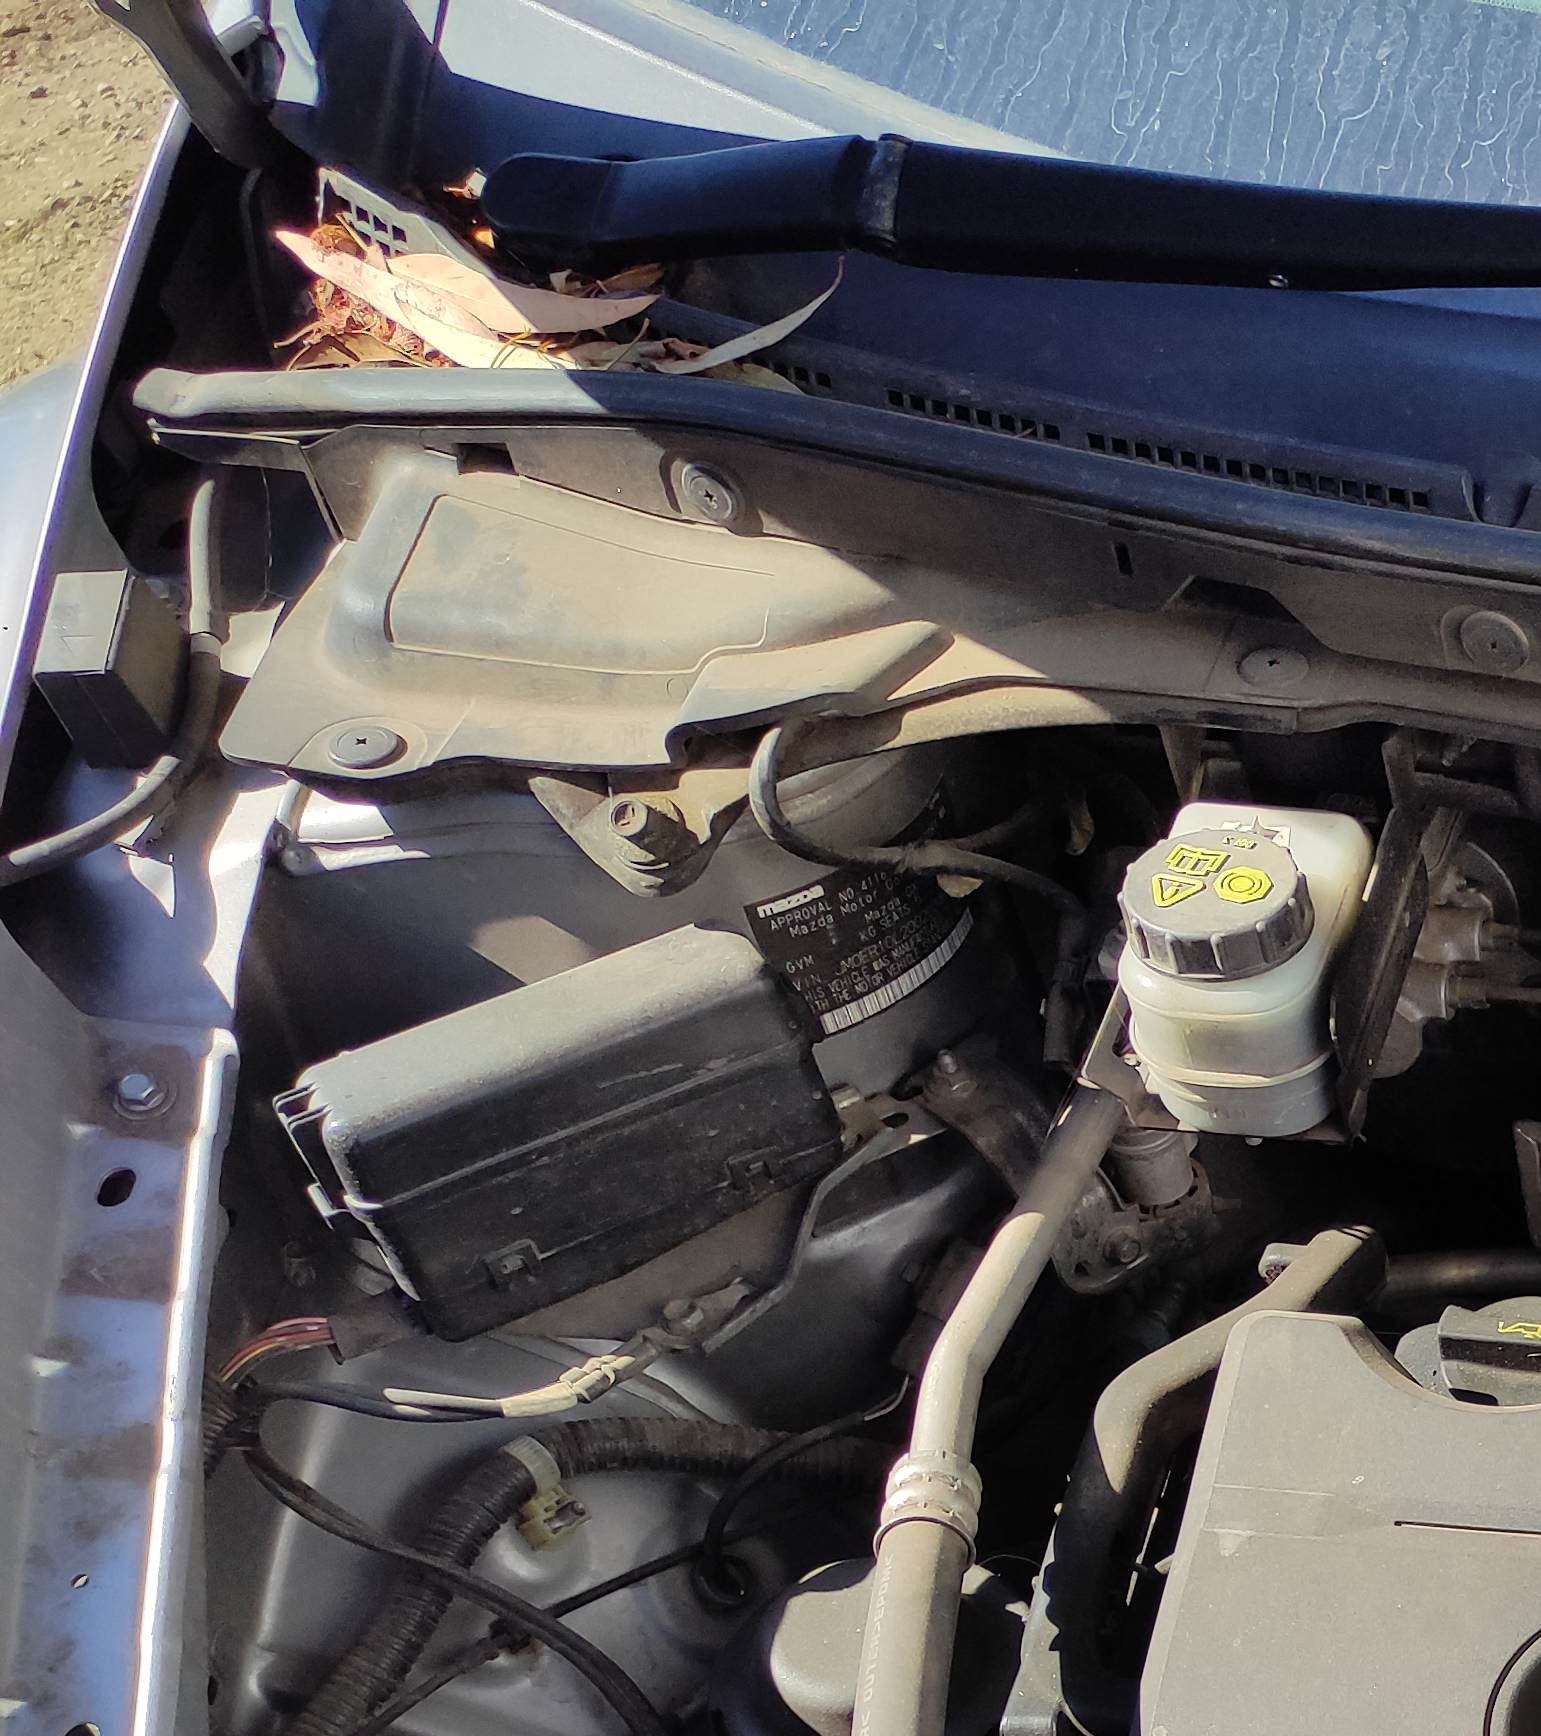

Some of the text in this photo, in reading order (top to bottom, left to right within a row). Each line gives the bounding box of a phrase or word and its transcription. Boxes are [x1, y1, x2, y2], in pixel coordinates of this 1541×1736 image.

[770, 901, 832, 931] APPROVAL
[789, 913, 834, 938] Mazda
[840, 890, 878, 916] Motor
[864, 896, 901, 923] Mazda
[785, 954, 815, 974] GVM
